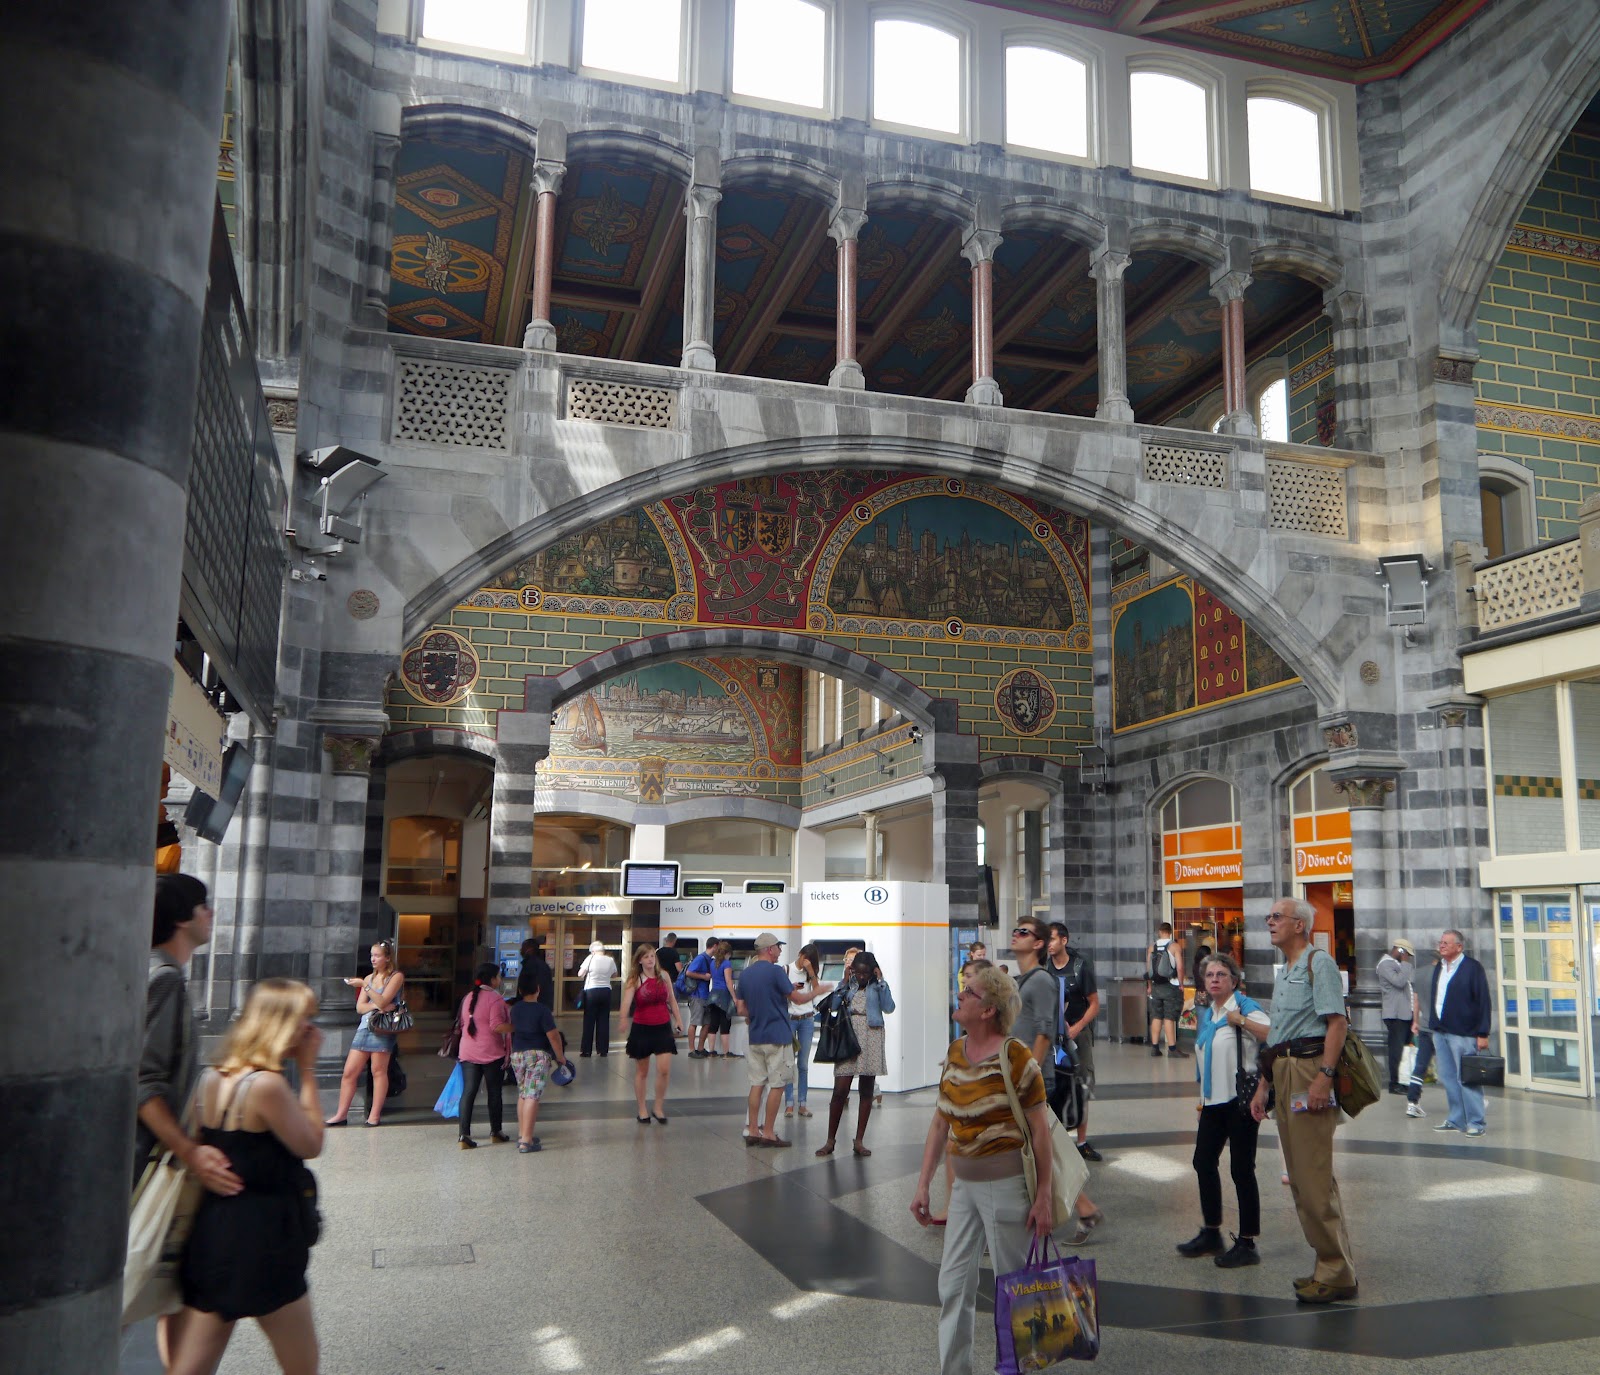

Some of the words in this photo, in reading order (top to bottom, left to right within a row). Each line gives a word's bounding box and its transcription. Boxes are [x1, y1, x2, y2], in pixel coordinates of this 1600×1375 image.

[681, 781, 715, 791] OSTENDE
[1307, 854, 1335, 867] Döner
[1182, 865, 1204, 878] Döner
[1205, 863, 1240, 878] Company
[810, 890, 840, 901] tickets
[566, 902, 607, 912] Centre
[719, 900, 742, 908] tickets
